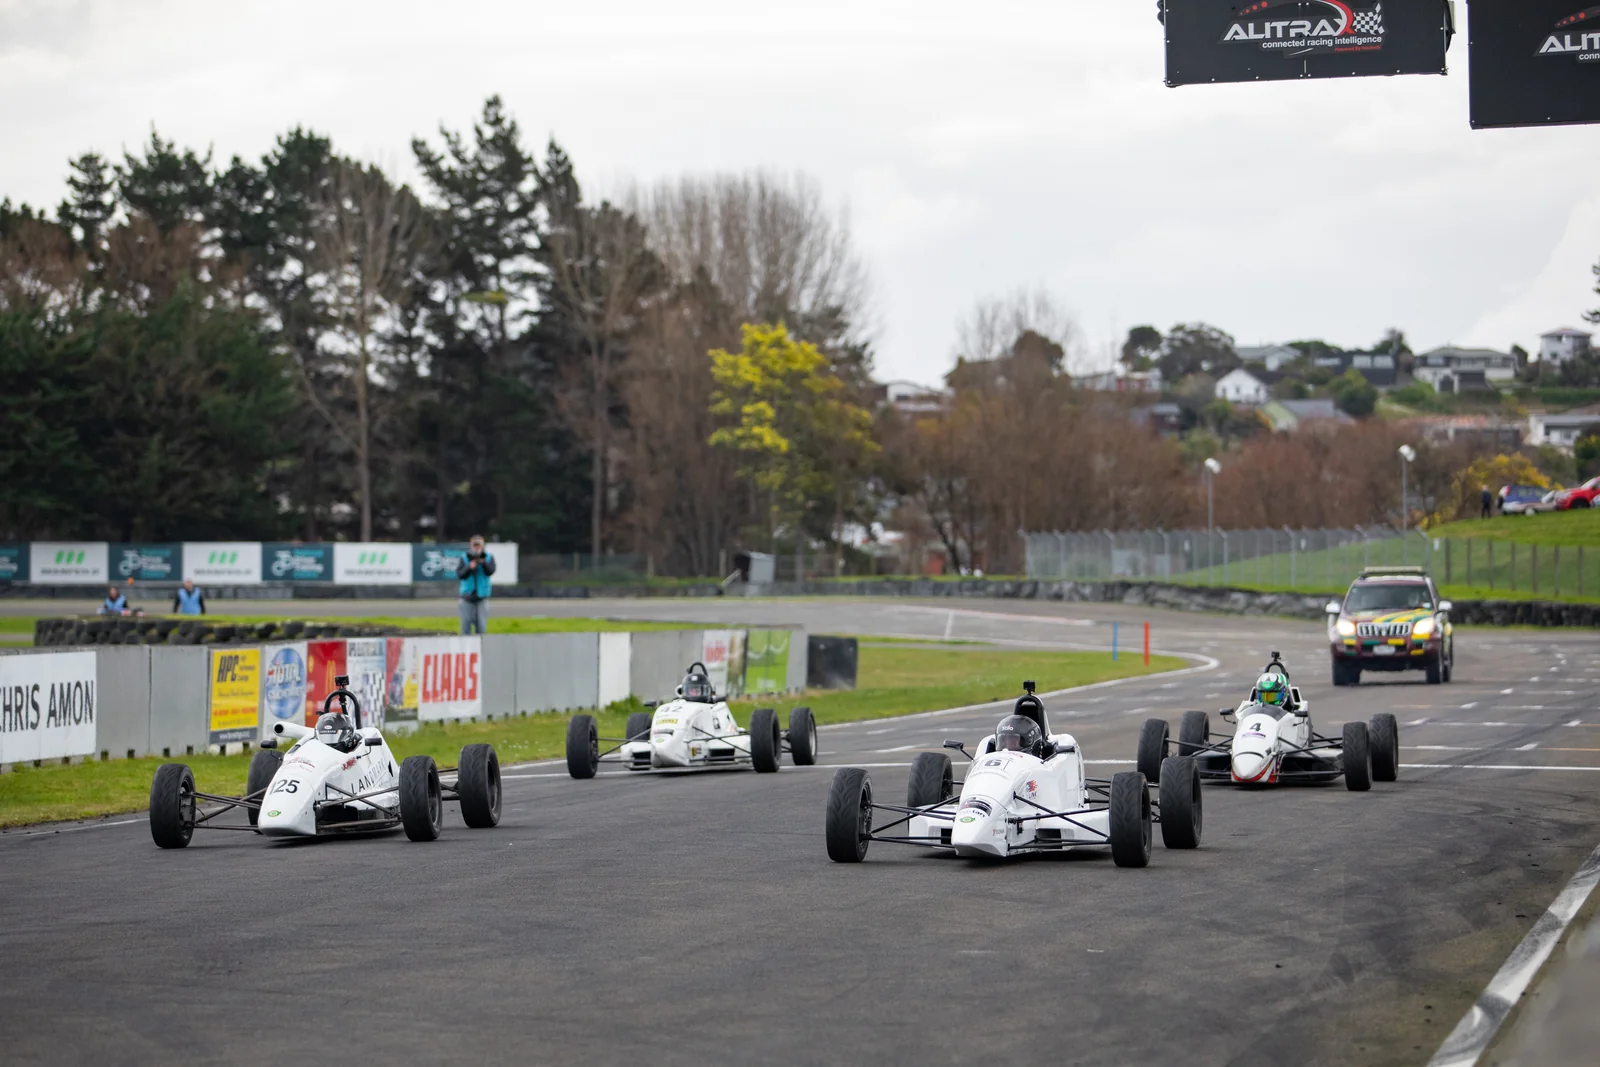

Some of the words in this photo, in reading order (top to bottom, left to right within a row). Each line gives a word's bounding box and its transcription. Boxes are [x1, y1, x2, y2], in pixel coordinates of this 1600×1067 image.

[1223, 18, 1355, 41] ALITRAX
[1262, 37, 1305, 49] connected
[1307, 38, 1333, 47] racing
[1335, 36, 1382, 46] intelligence
[217, 655, 239, 682] HPC
[422, 653, 478, 703] CLAAS
[0, 683, 40, 733] HRIS
[47, 680, 93, 728] AMON
[1249, 722, 1261, 731] 4
[984, 759, 1001, 767] 6
